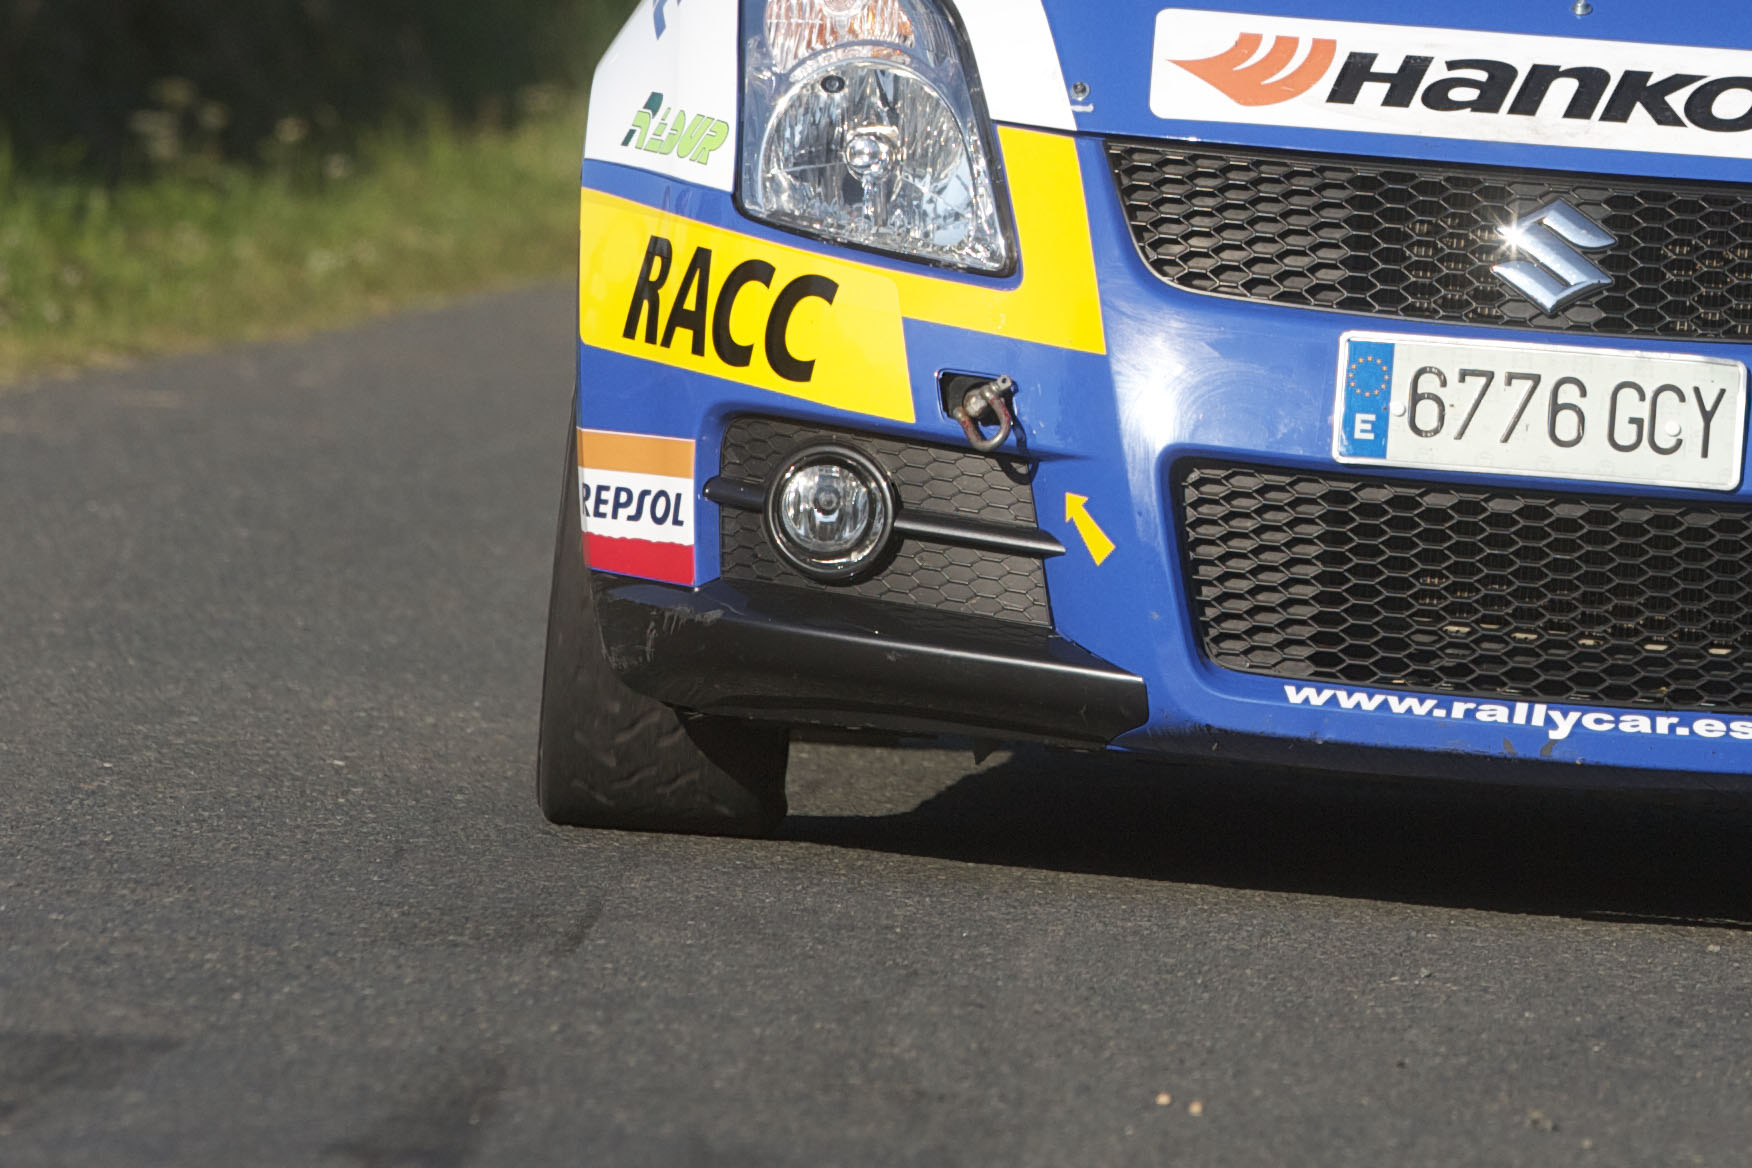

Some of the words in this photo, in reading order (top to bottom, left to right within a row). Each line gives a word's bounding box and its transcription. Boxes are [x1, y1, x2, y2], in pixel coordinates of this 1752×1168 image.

[622, 235, 840, 382] RACC
[1353, 413, 1376, 440] E
[1407, 366, 1588, 449] 6776
[1607, 380, 1727, 459] GCY
[582, 482, 685, 528] REPSOL
